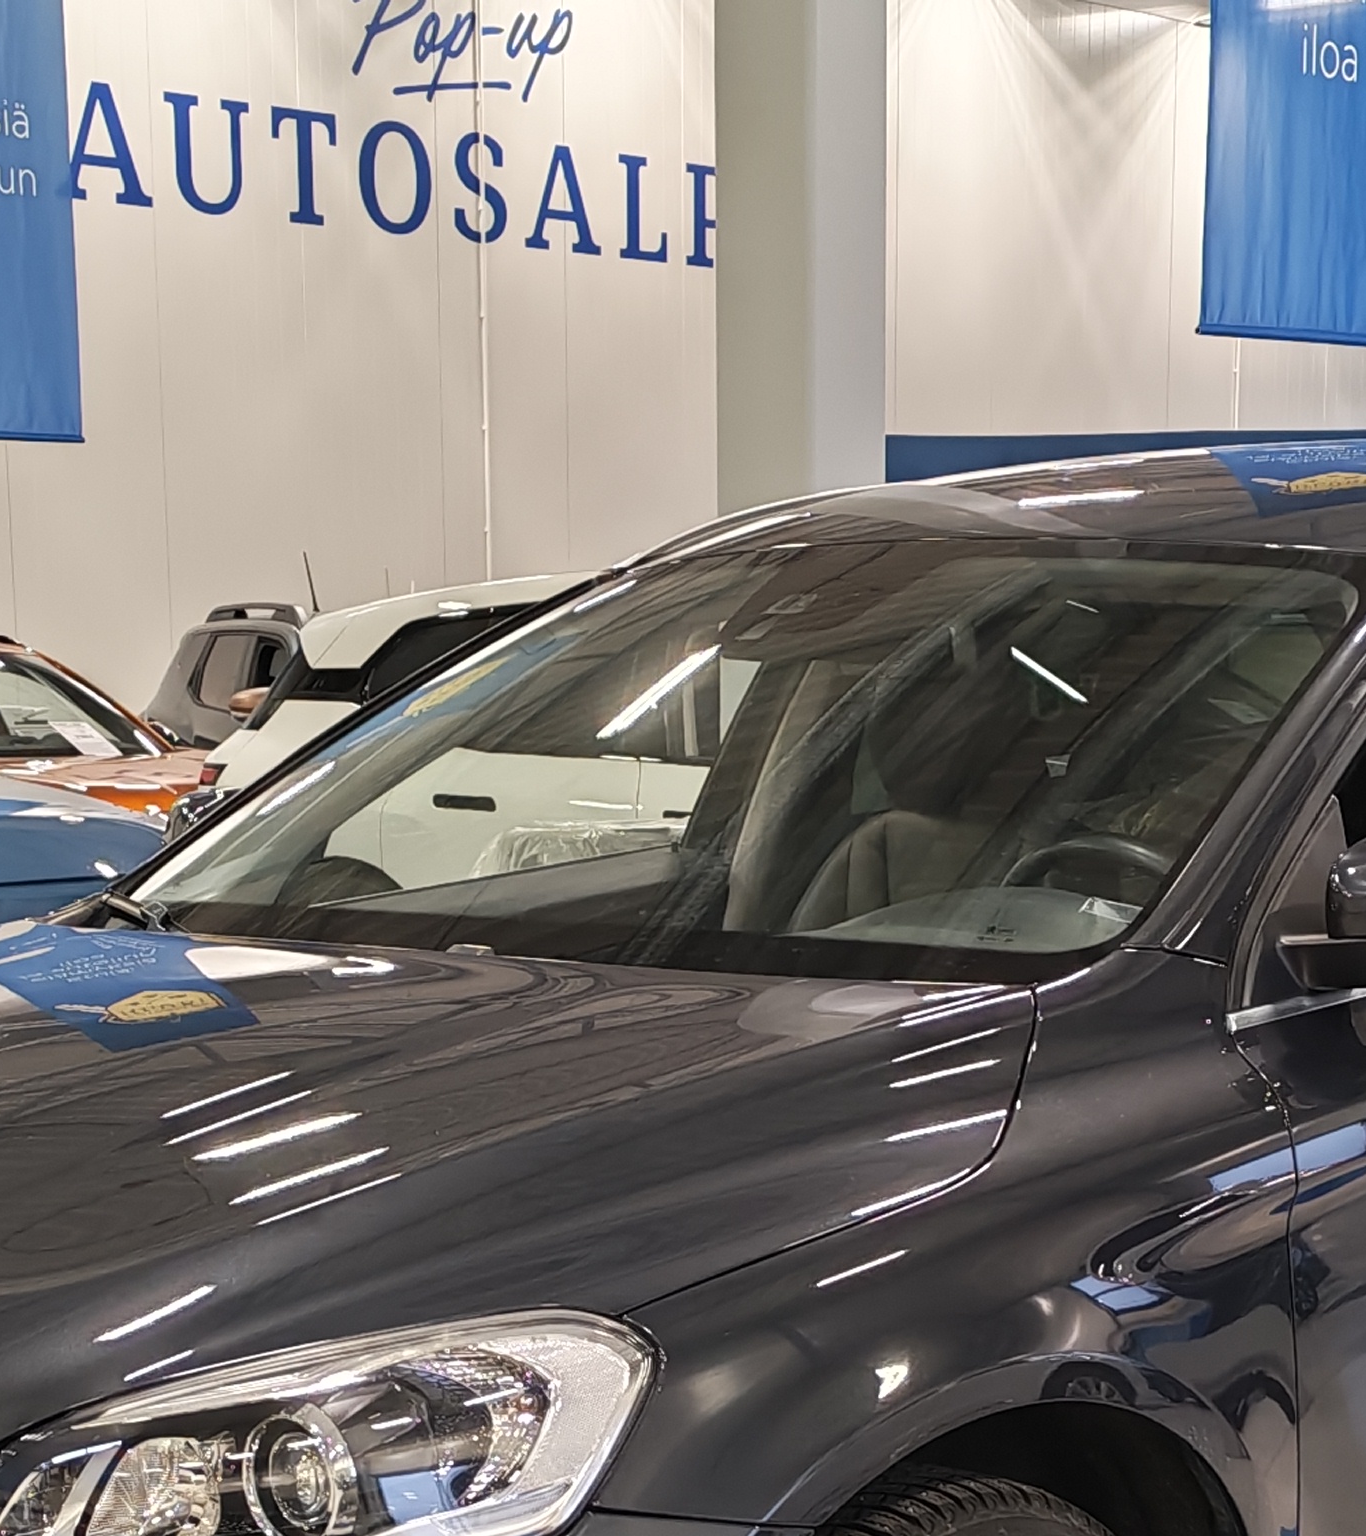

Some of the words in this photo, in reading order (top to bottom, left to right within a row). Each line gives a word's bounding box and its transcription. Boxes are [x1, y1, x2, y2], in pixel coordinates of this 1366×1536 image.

[352, 0, 573, 102] Pop-up
[1301, 23, 1358, 83] iloa
[68, 81, 716, 268] AUTOSALP
